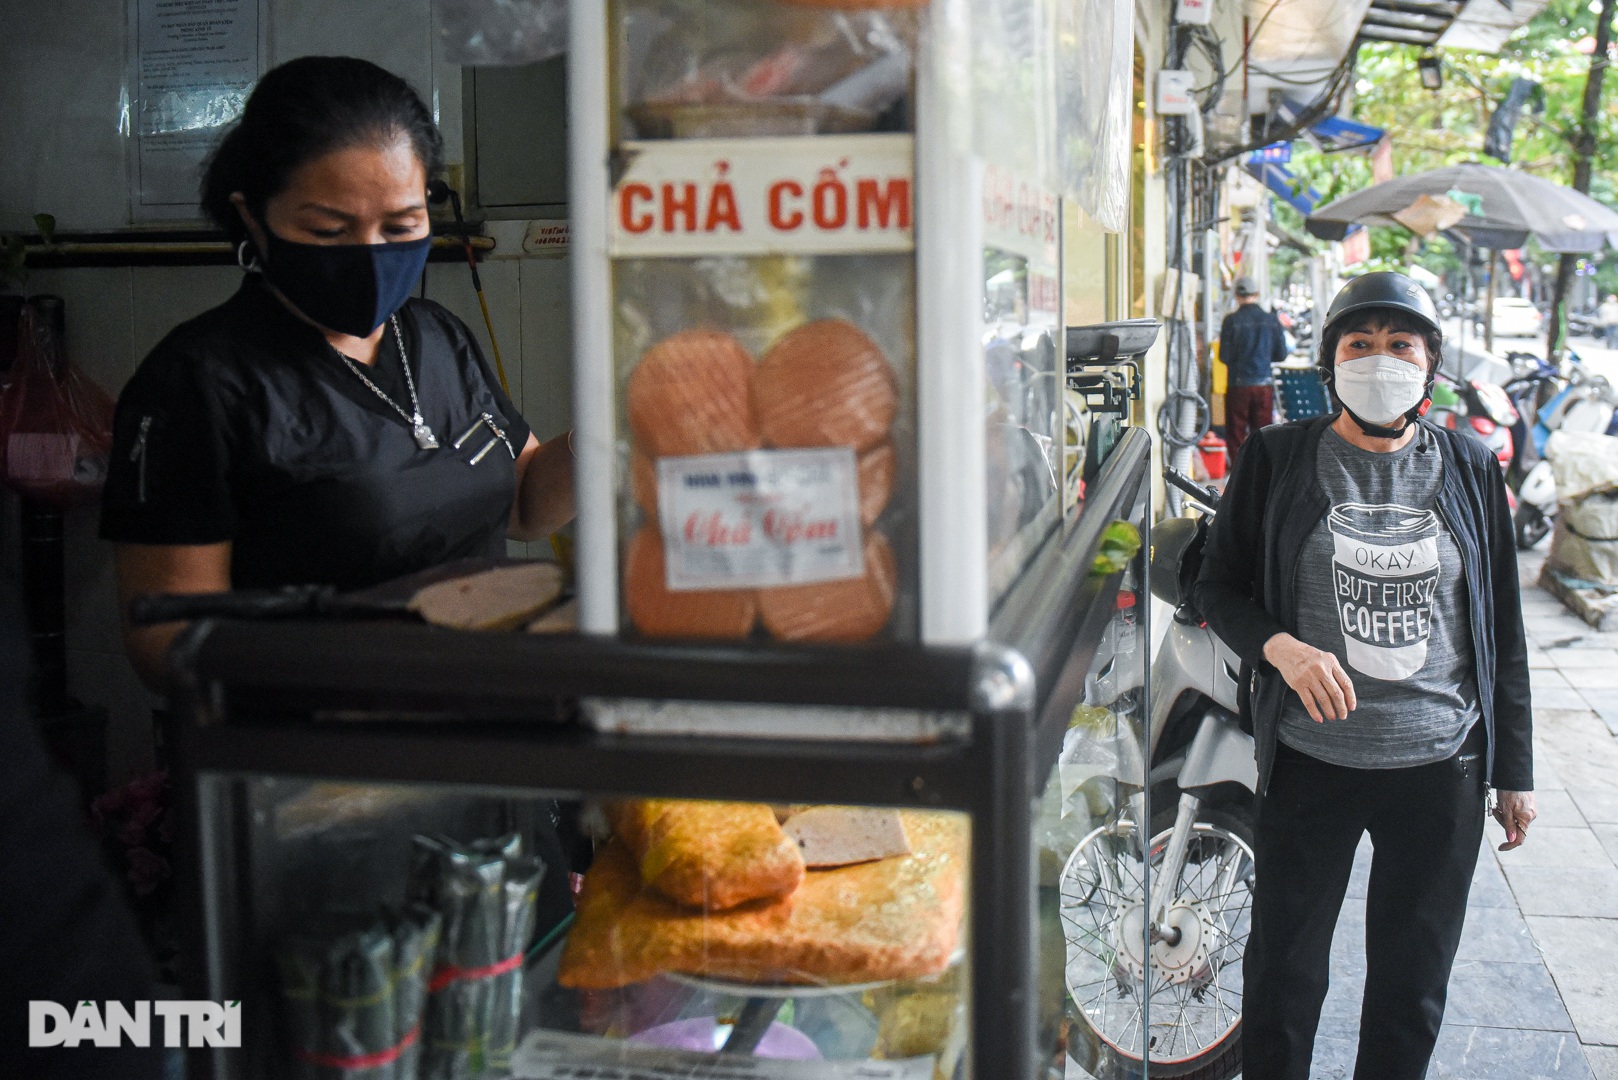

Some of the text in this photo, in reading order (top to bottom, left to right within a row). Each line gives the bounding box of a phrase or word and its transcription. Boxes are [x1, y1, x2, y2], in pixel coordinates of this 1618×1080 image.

[619, 158, 742, 234] CHẢ
[767, 156, 911, 231] CỐM
[1337, 569, 1437, 607] BUT FIRST
[1343, 602, 1429, 644] COFFEE
